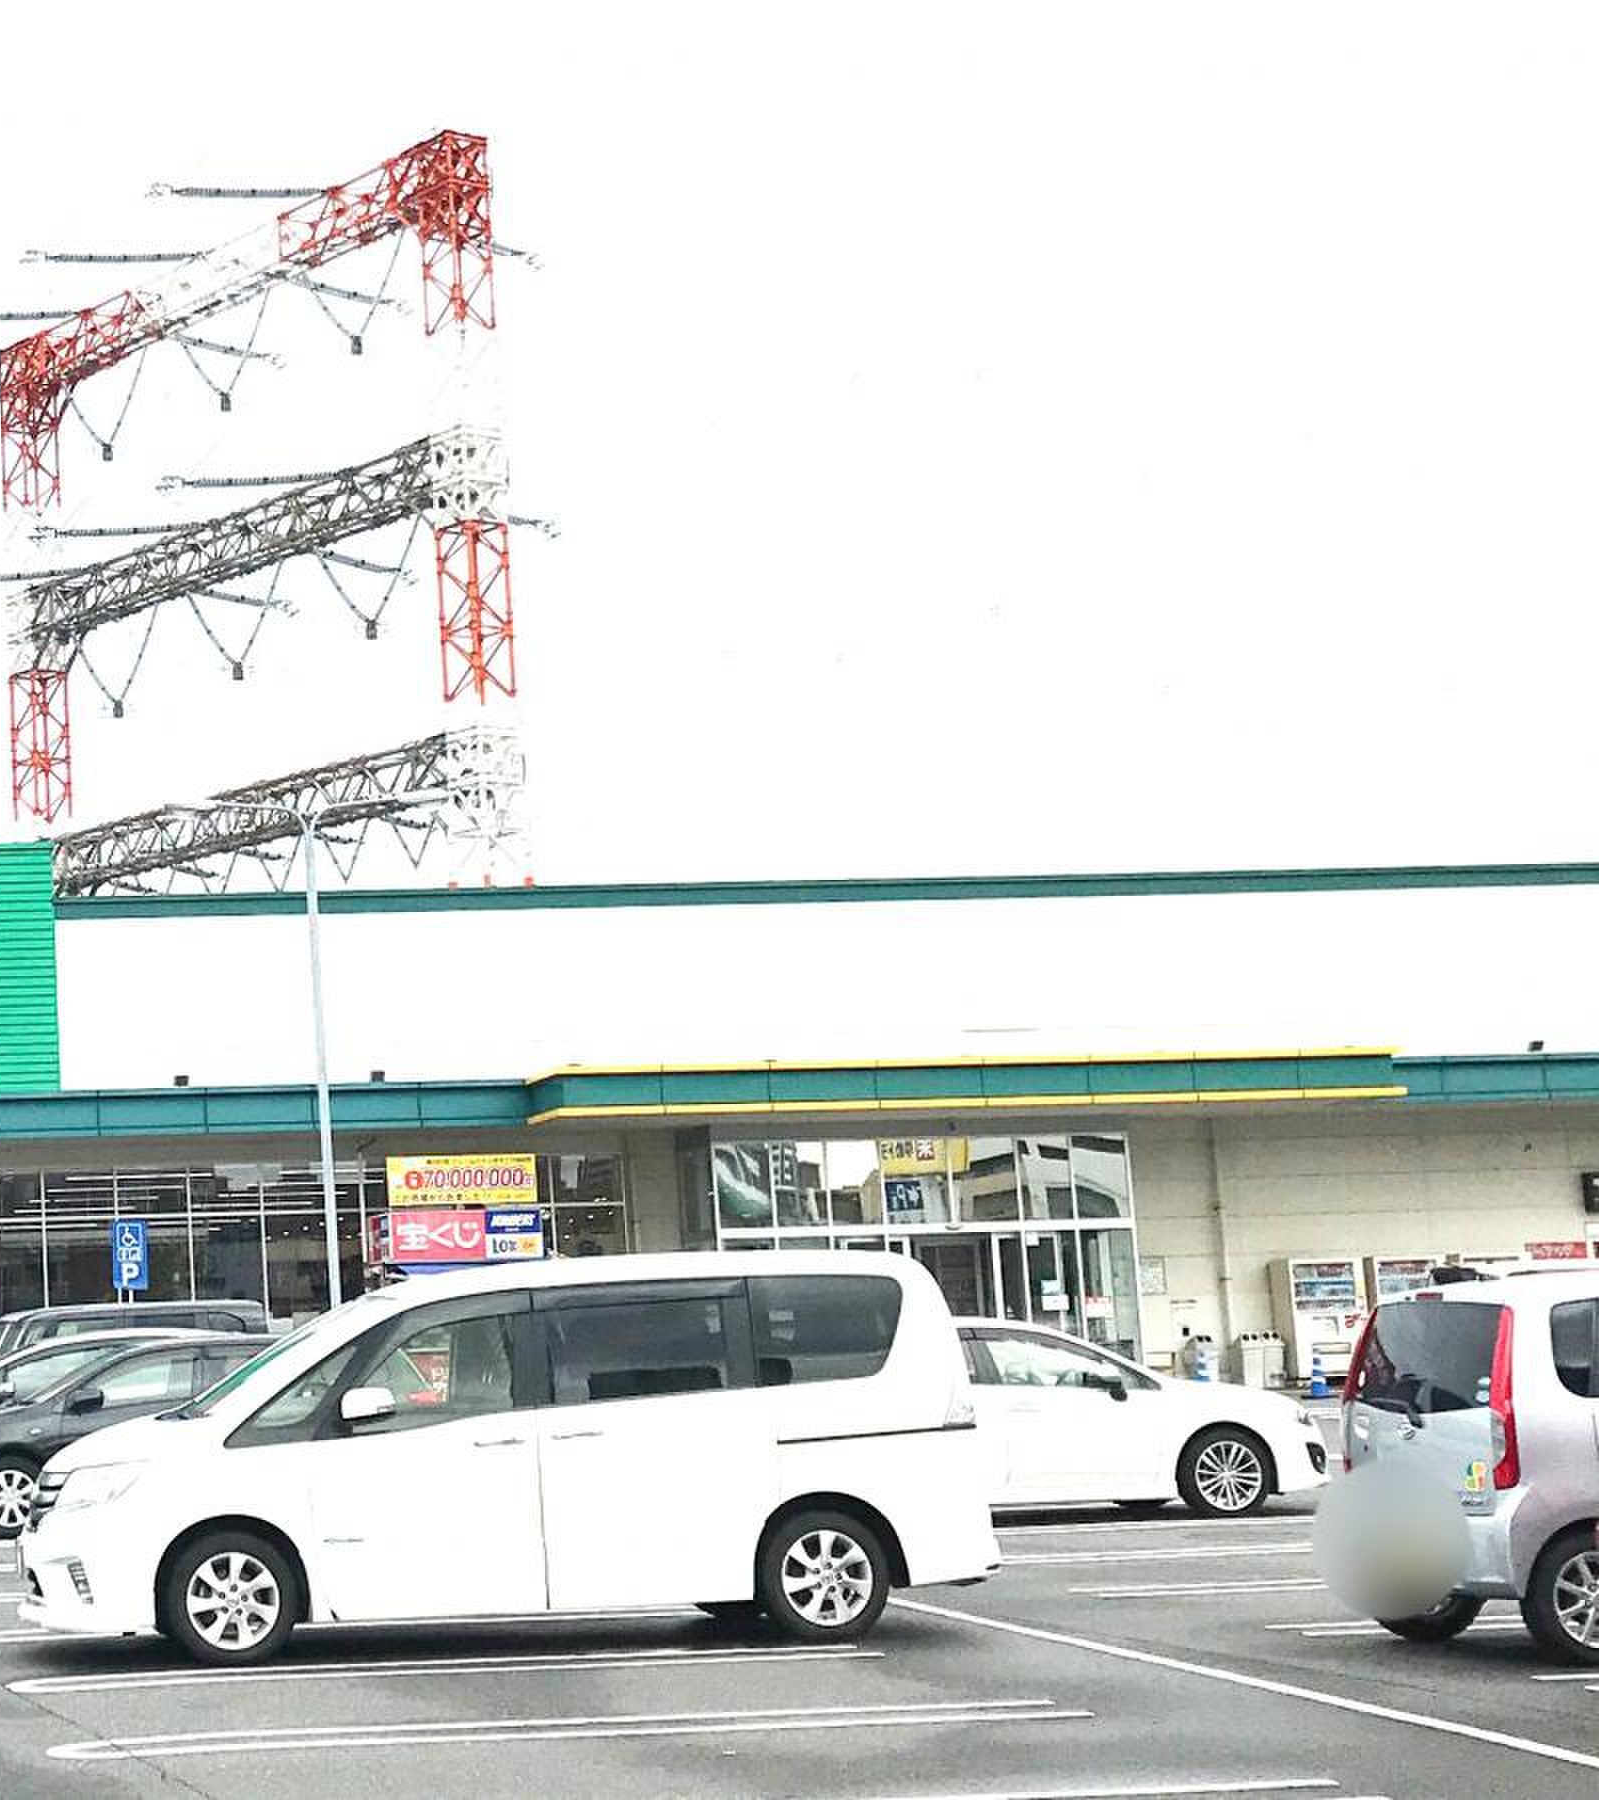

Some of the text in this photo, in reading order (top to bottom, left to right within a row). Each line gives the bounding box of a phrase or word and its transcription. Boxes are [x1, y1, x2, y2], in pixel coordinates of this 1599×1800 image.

[396, 1221, 481, 1249] 宝くじ
[121, 1263, 139, 1287] P
